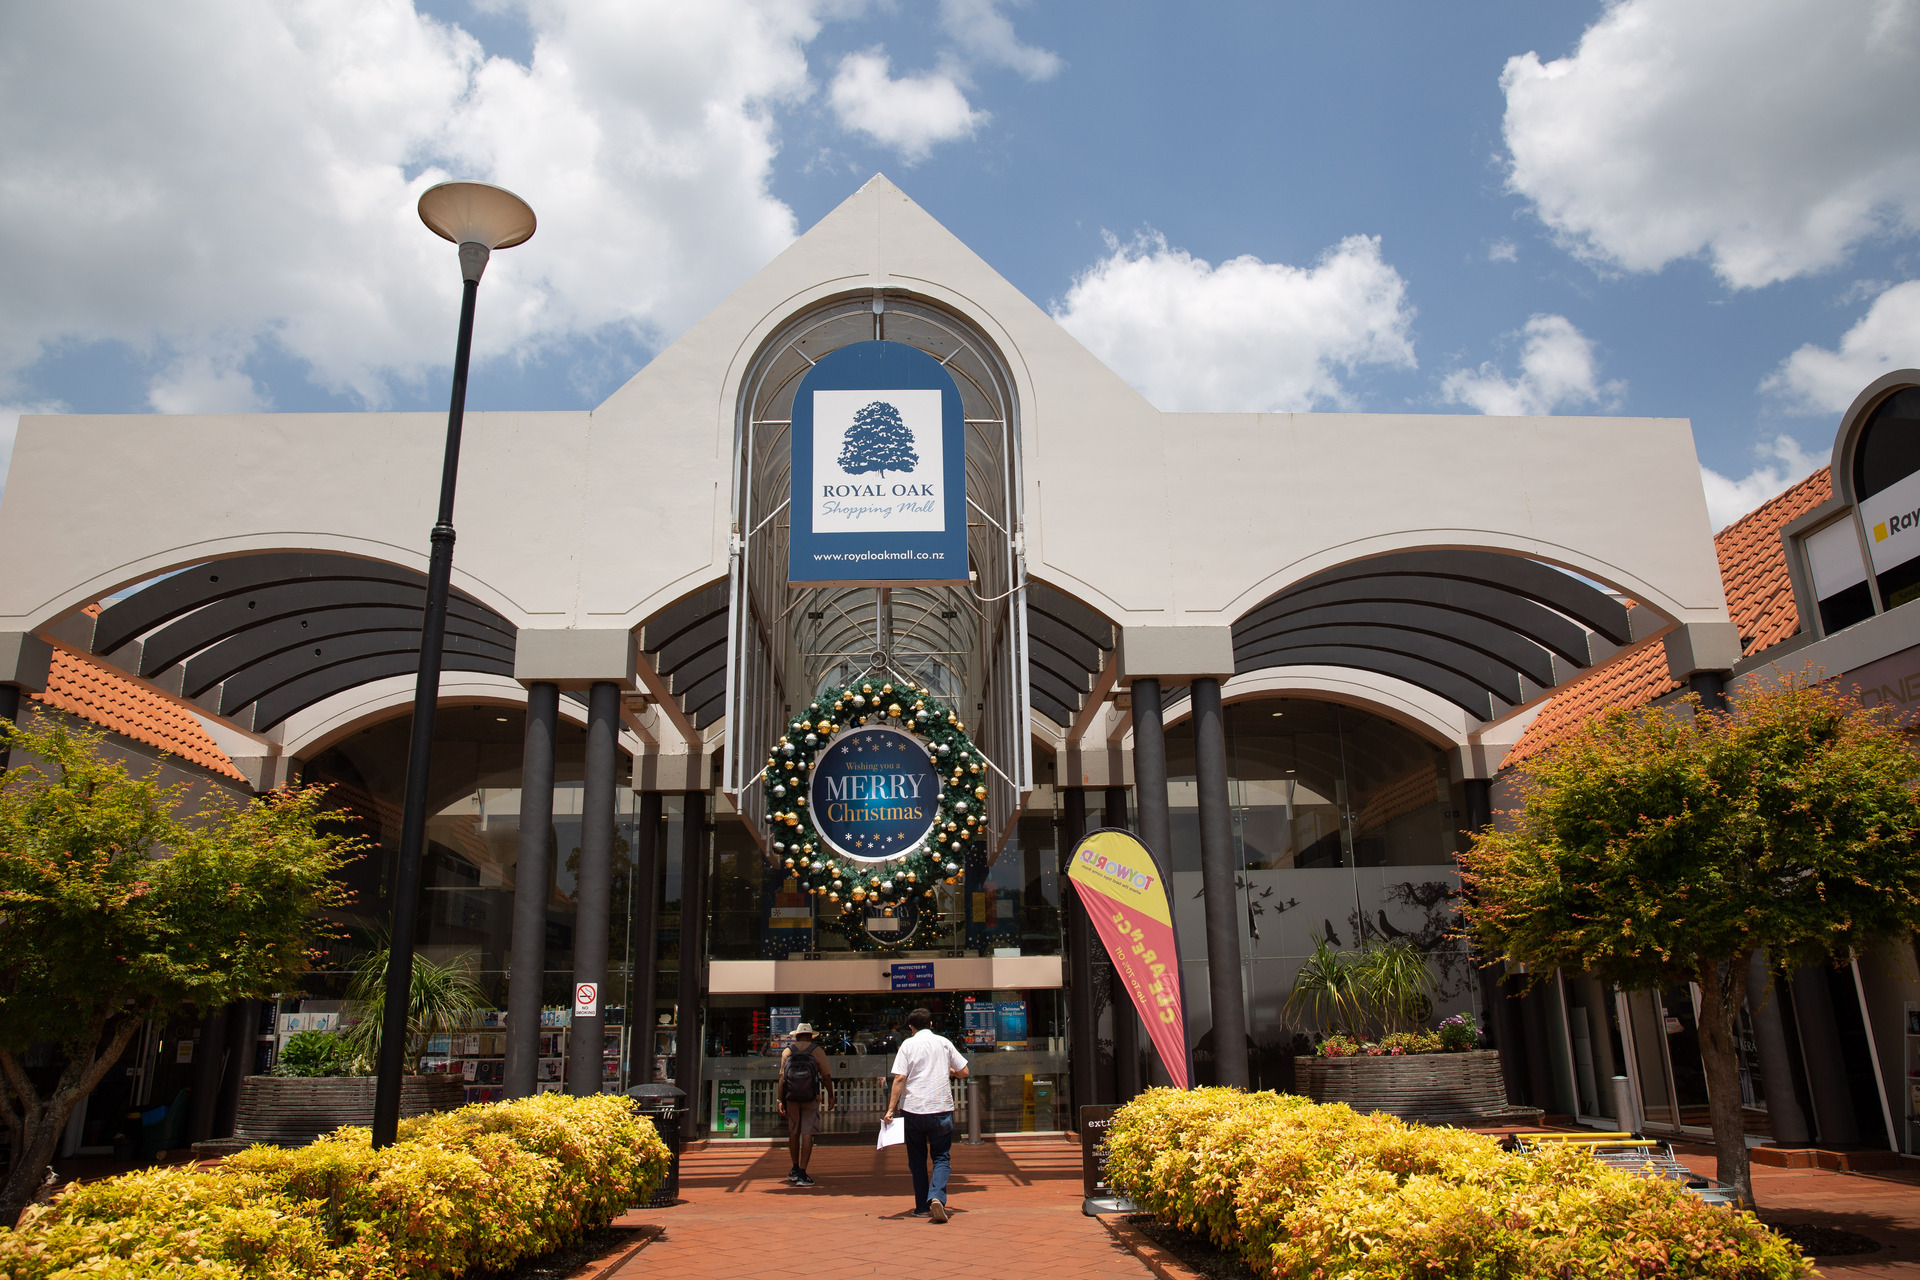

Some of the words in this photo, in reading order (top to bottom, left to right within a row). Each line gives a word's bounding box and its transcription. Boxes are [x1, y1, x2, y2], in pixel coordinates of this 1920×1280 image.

[823, 484, 886, 498] ROYAL
[892, 483, 935, 497] OAK
[822, 500, 892, 519] Shopping
[897, 500, 936, 513] Mall
[813, 550, 945, 563] www.royaloakmall.co.nz
[845, 762, 879, 772] Wishing
[879, 763, 895, 771] you
[825, 773, 926, 801] MERRY
[827, 802, 923, 823] Christmas
[720, 1086, 746, 1095] Repair
